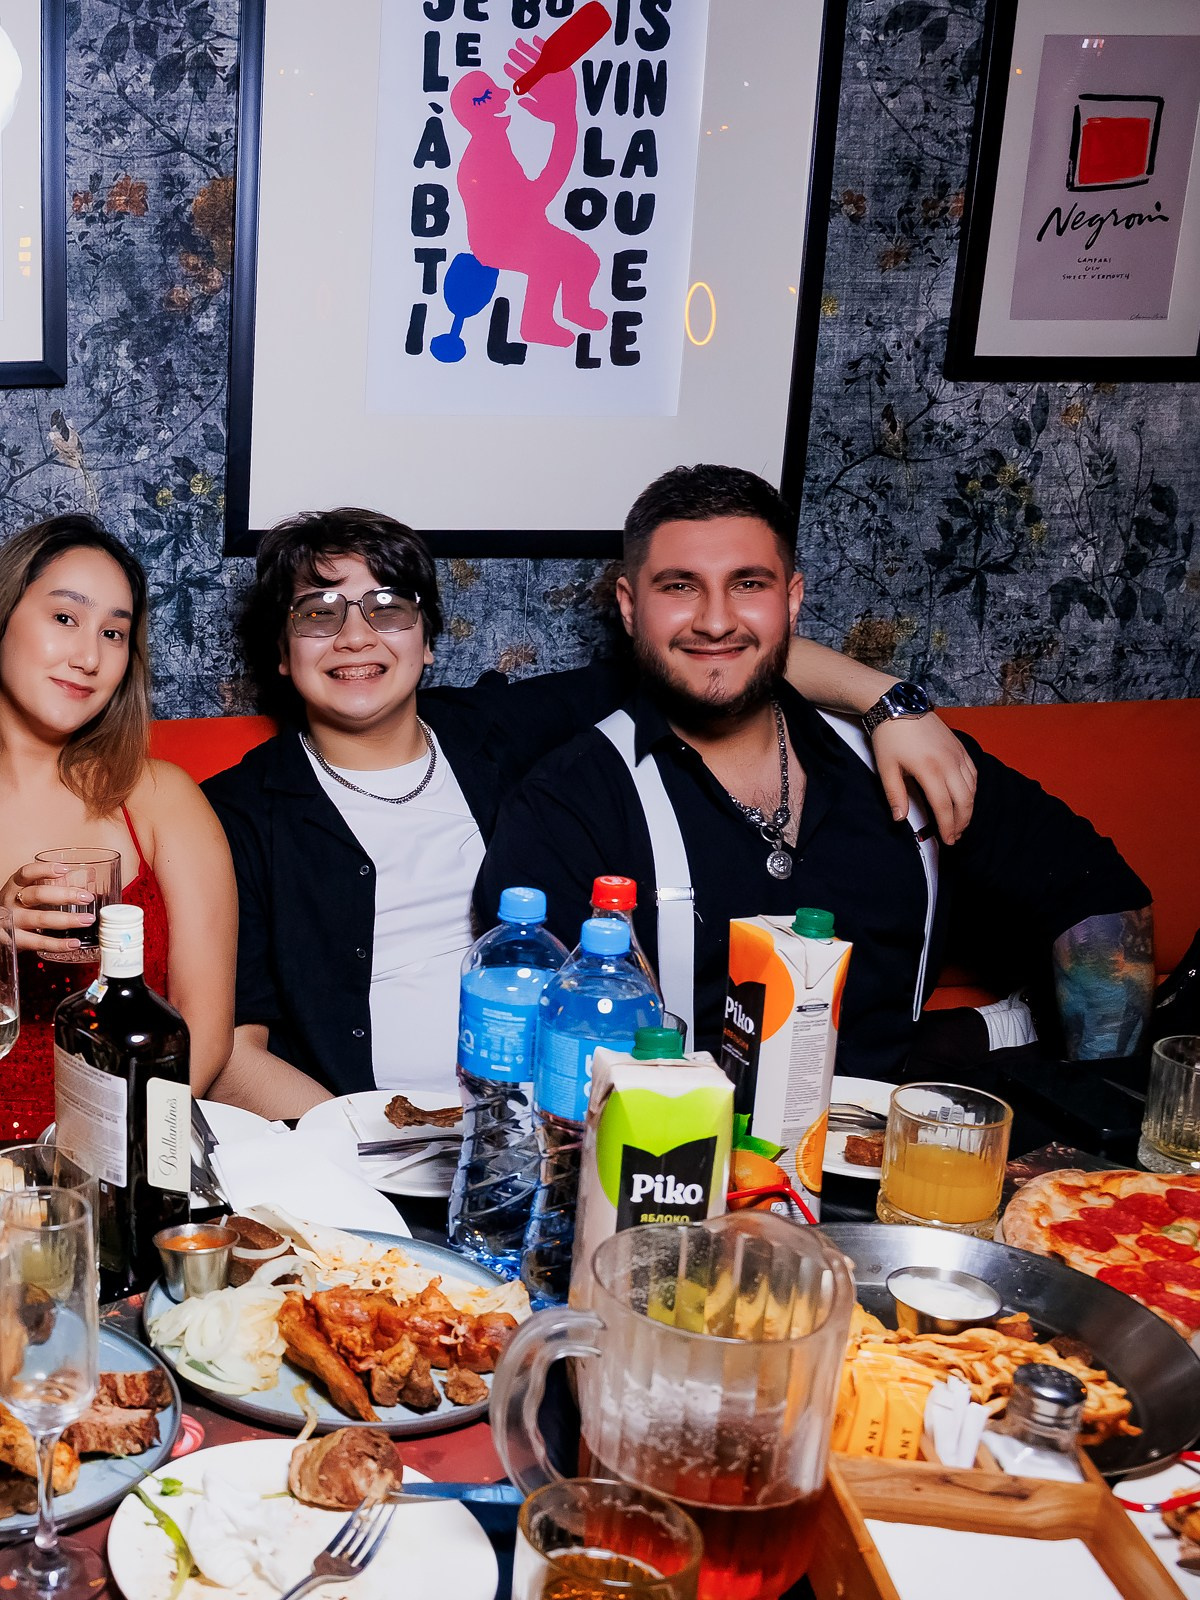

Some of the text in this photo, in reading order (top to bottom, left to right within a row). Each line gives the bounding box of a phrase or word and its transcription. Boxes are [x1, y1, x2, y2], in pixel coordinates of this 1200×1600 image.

[423, 31, 667, 119] LE VIN
[413, 102, 658, 178] À LA
[1036, 201, 1170, 251] Negroni
[1090, 272, 1130, 280] VERMOUTH
[724, 995, 755, 1035] Piko
[629, 1173, 704, 1205] Piko
[640, 1213, 690, 1224] ЯБЛОКО
